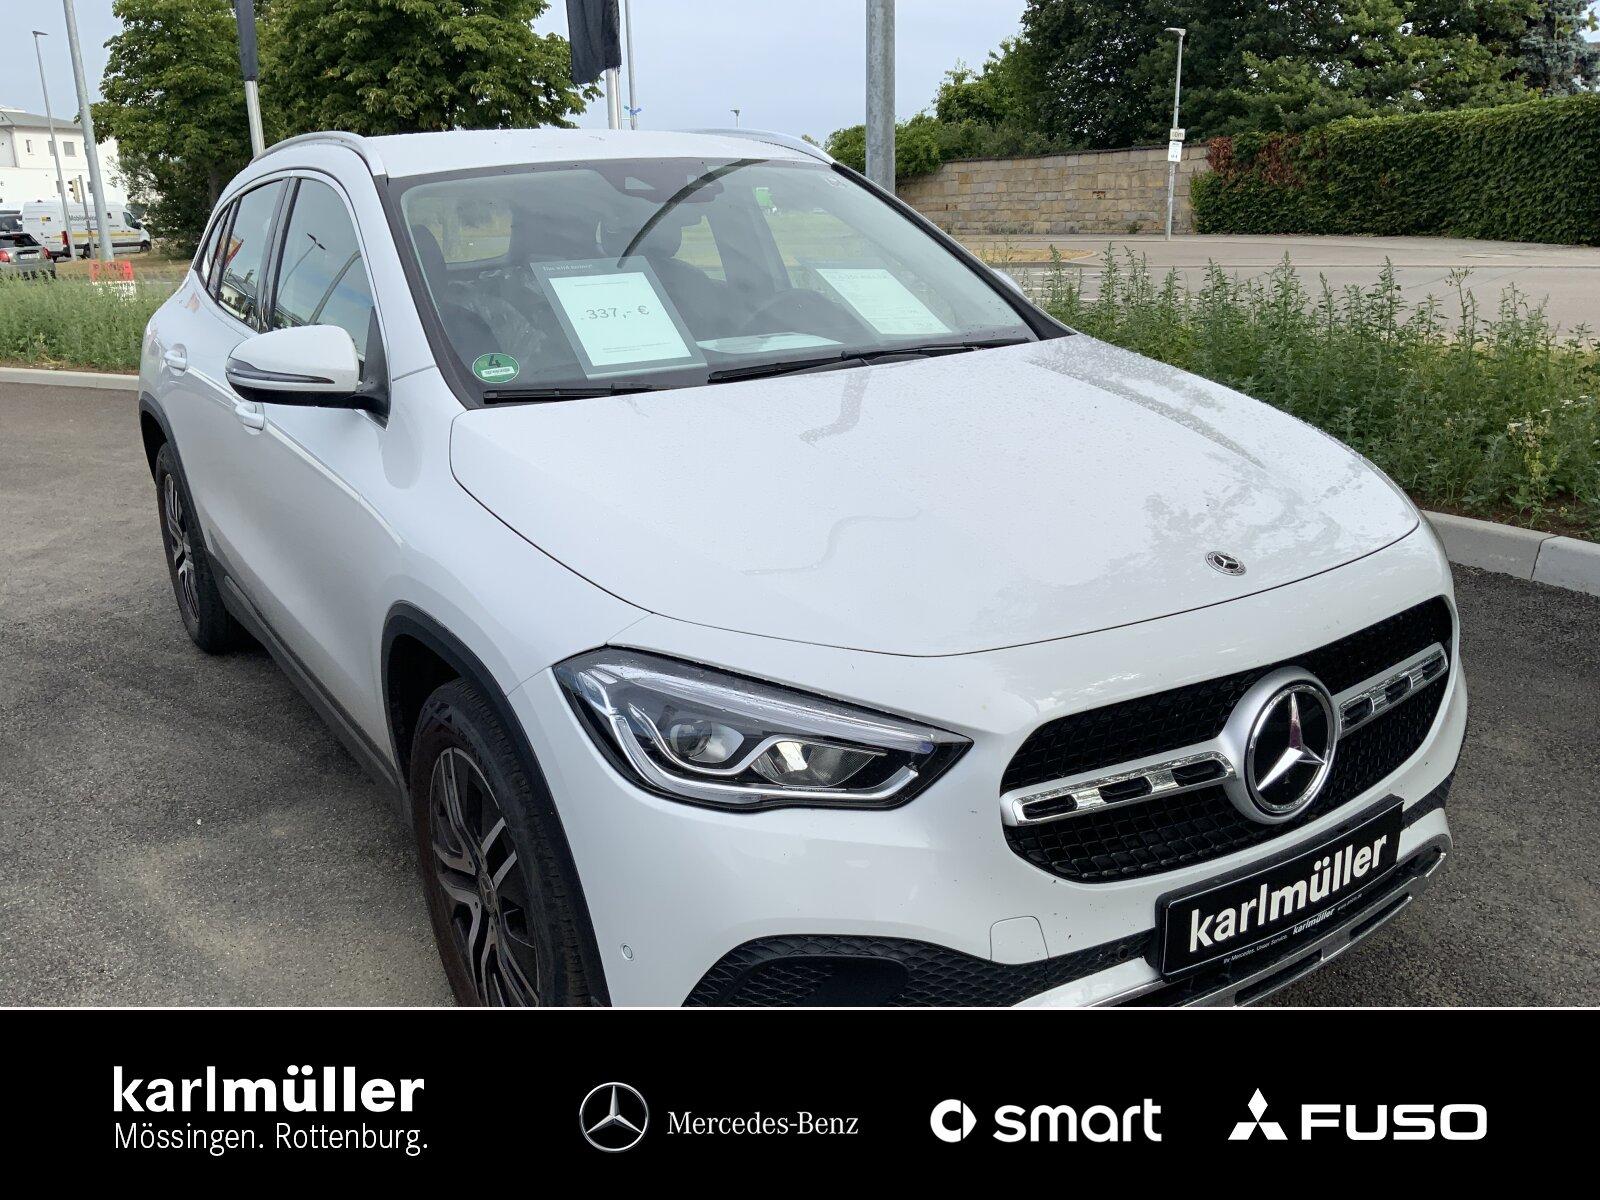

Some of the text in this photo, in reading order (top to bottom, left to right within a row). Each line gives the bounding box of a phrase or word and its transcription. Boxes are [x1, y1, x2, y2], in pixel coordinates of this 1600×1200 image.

[637, 305, 650, 315] €
[488, 354, 502, 368] 4
[1189, 834, 1387, 953] karlmüller
[1292, 908, 1335, 936] karlmüller
